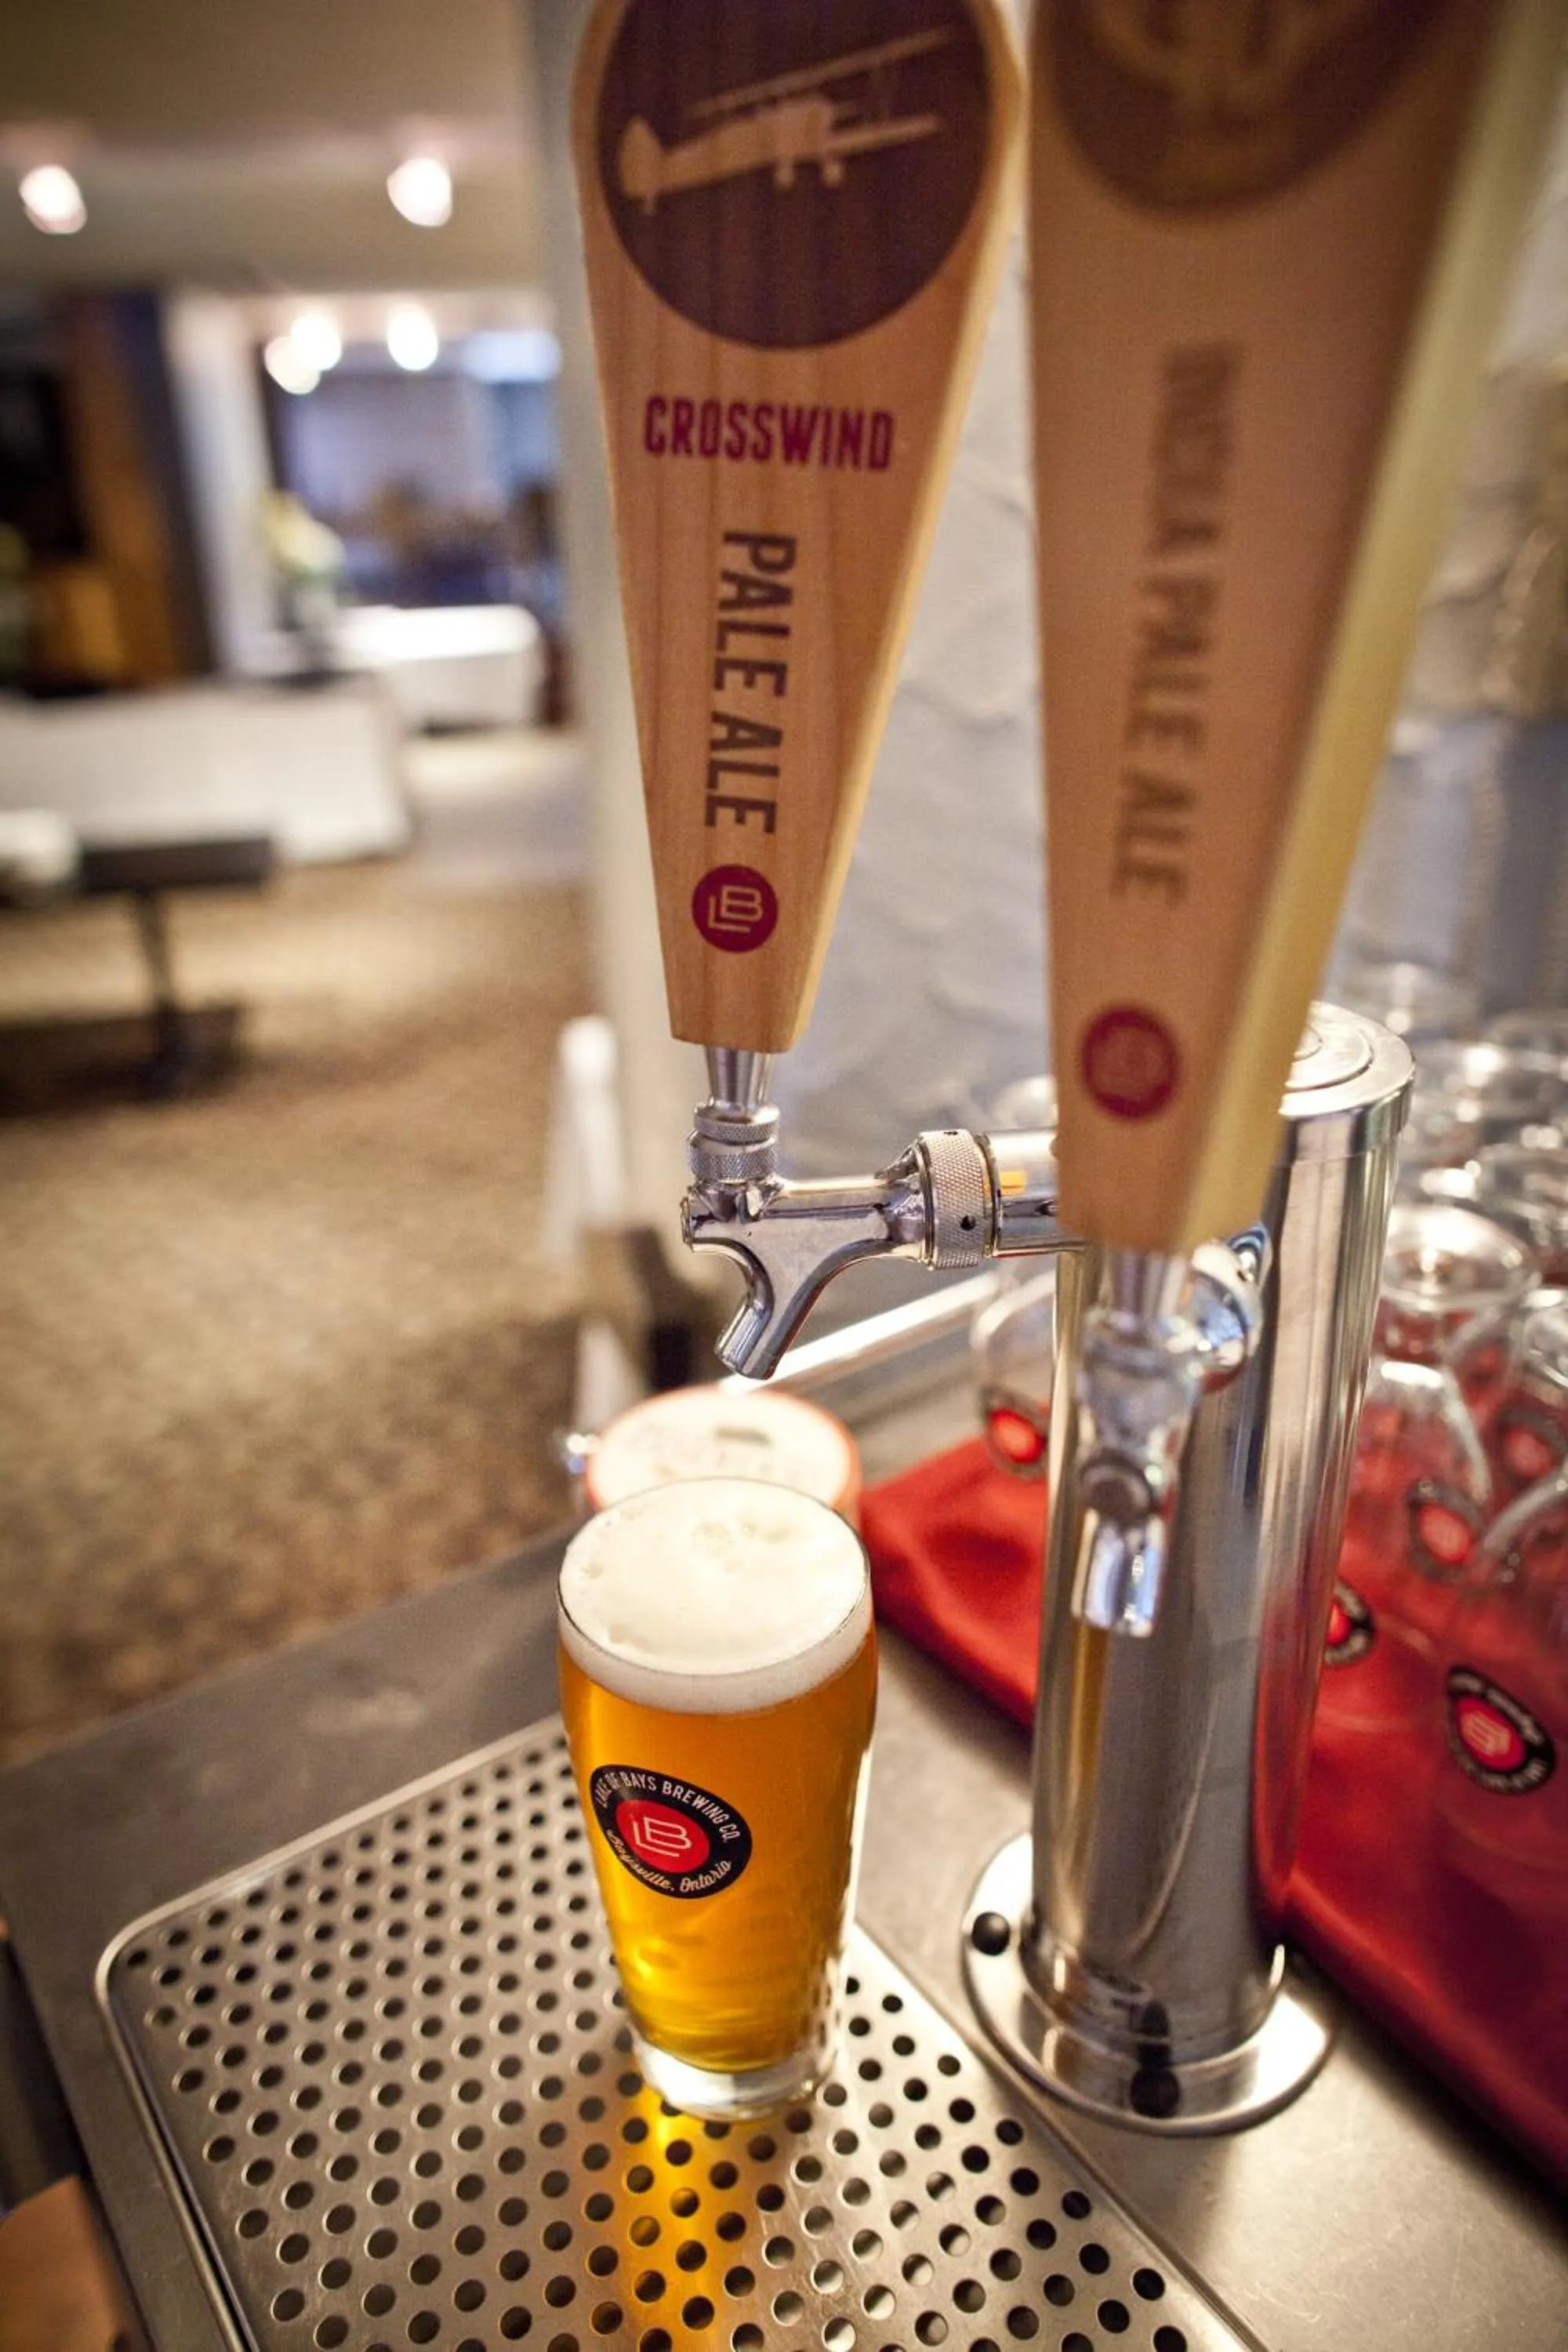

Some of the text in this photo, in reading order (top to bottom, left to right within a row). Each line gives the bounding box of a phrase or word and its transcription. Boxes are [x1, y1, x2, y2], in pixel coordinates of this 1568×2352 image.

[644, 395, 895, 472] CROSSWIND
[703, 530, 798, 834] PALE ALE
[1112, 768, 1199, 908] ALE
[619, 1772, 657, 1791] BAYS
[662, 1780, 730, 1824] BREWING
[680, 1860, 732, 1893] Ontario
